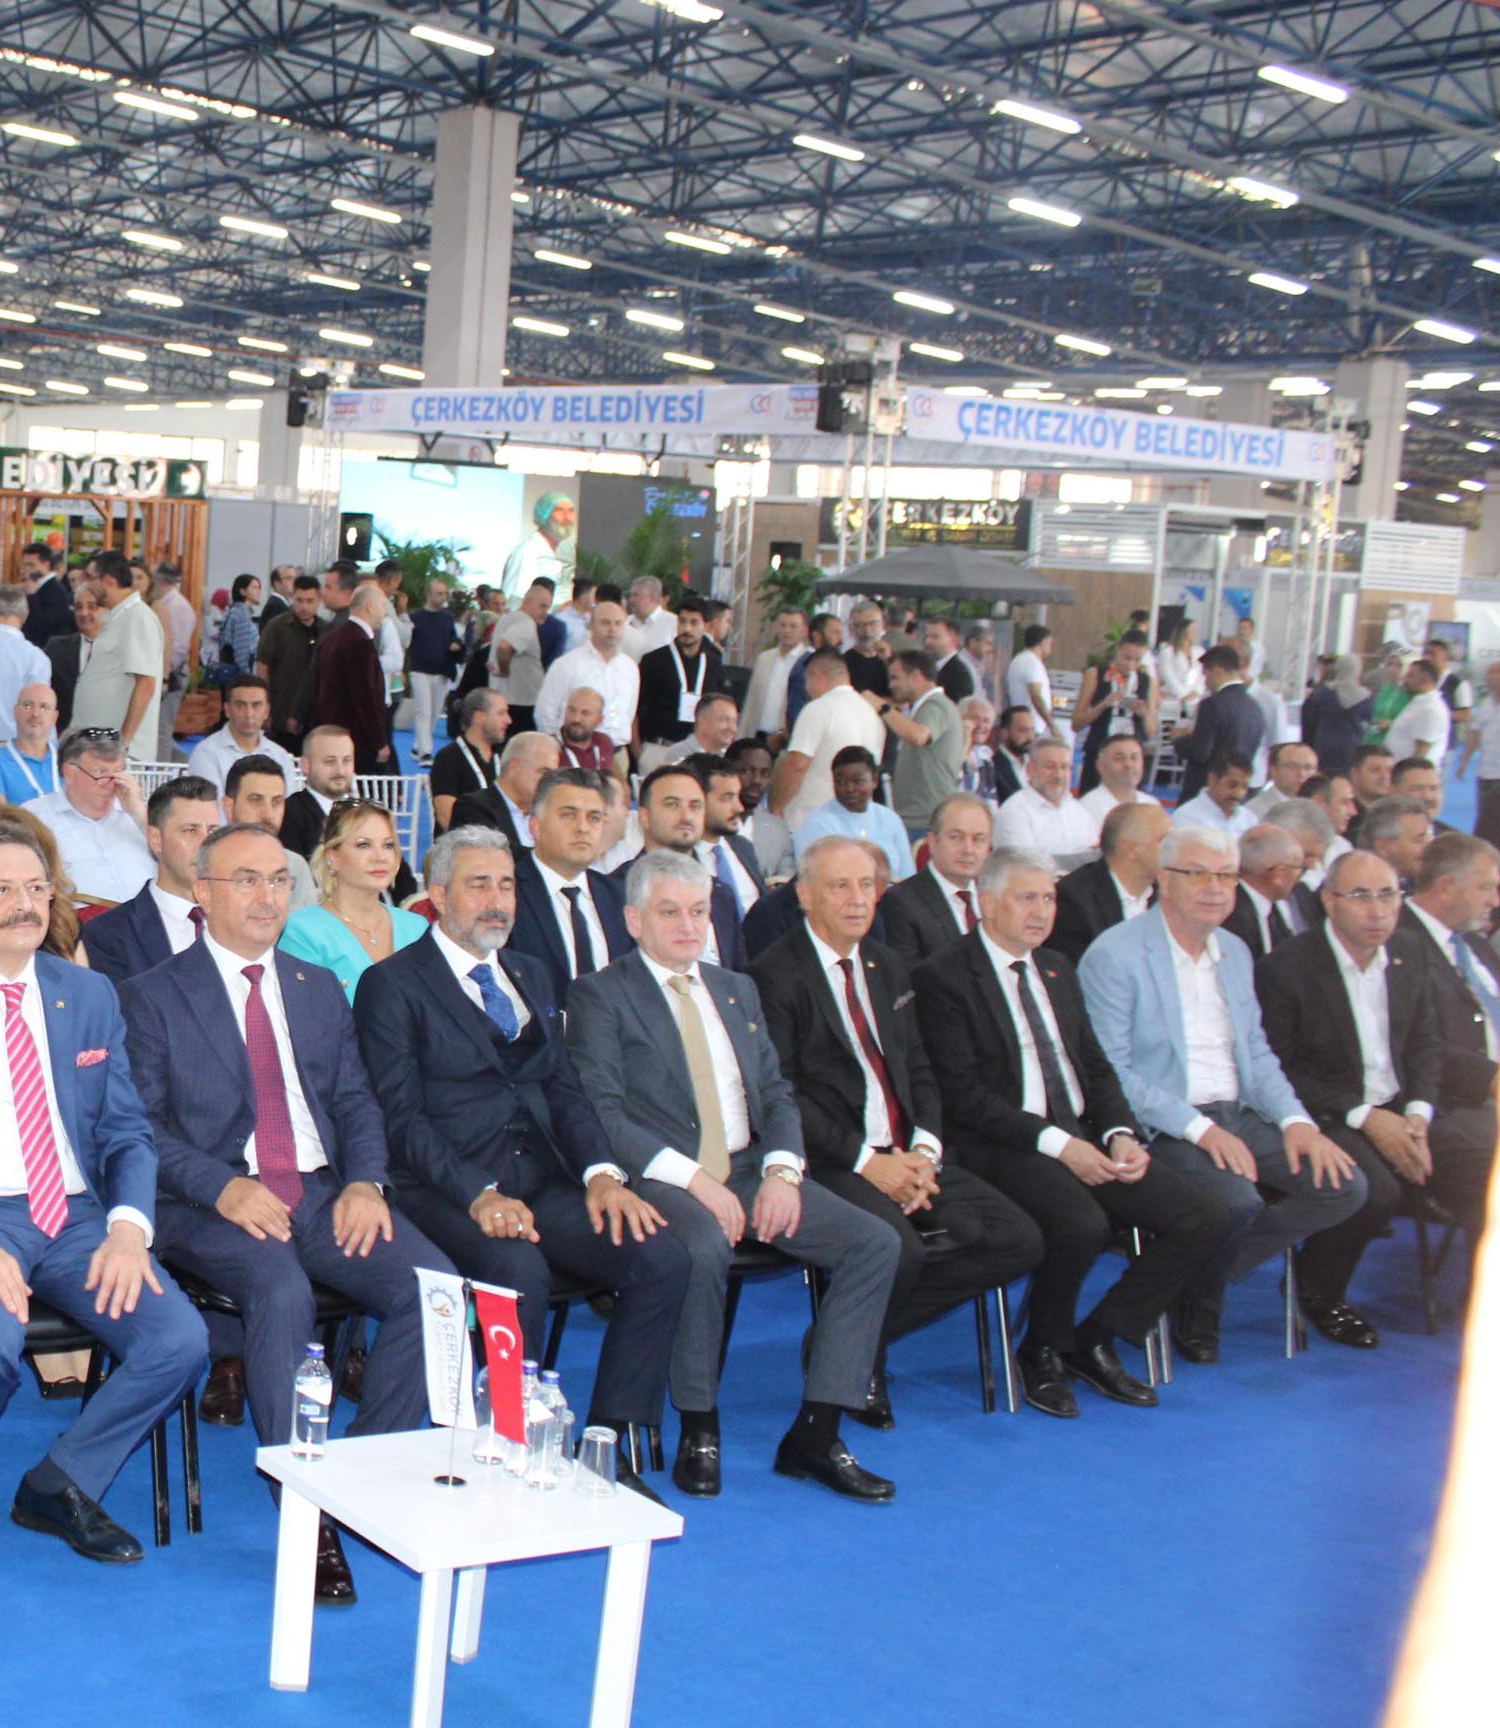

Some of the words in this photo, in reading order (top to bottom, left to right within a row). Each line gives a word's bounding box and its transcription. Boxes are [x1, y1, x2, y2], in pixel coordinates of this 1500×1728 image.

[411, 390, 545, 427] ÇERKEZKÖY
[552, 389, 705, 423] BELEDİYESİ
[958, 401, 1128, 447] ÇERKEZKÖY
[1135, 421, 1286, 467] BELEDİYESİ
